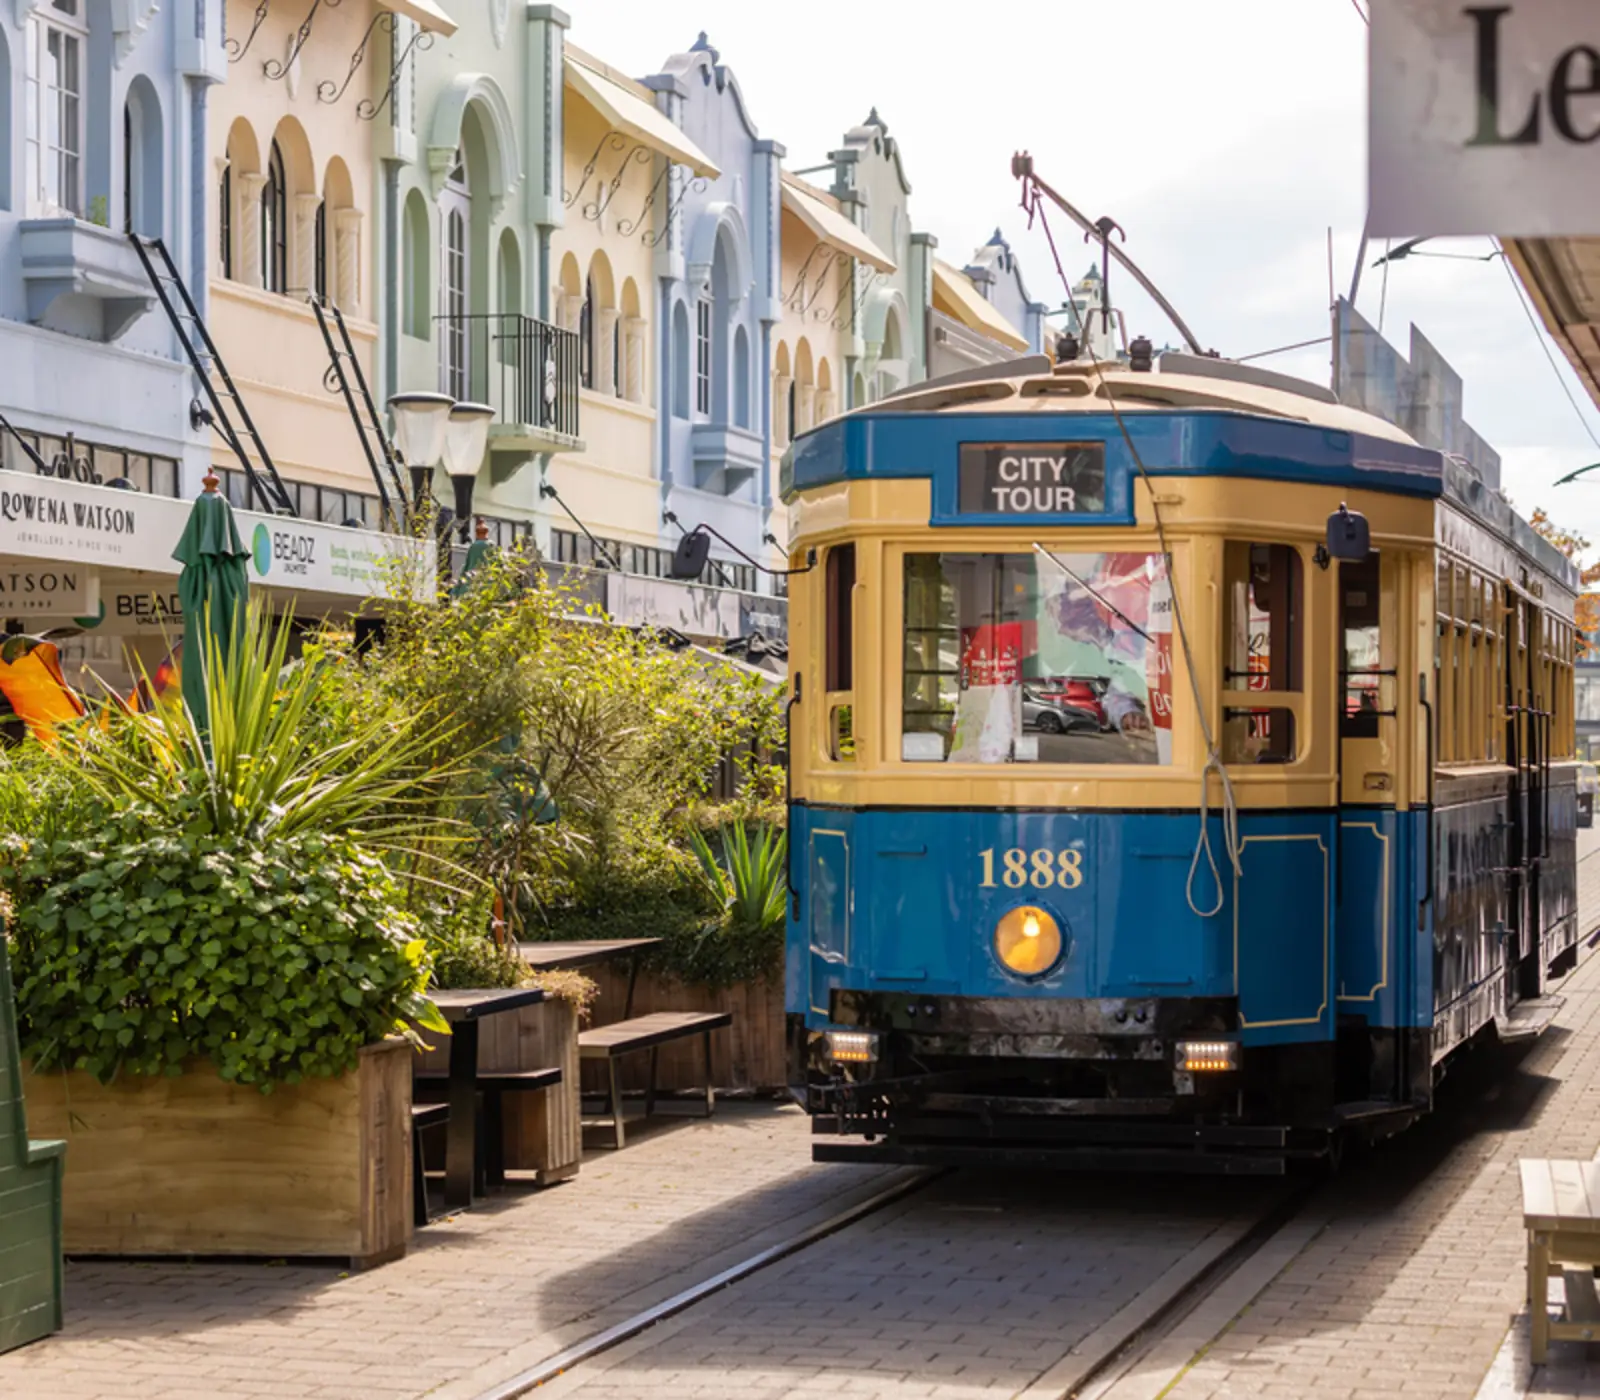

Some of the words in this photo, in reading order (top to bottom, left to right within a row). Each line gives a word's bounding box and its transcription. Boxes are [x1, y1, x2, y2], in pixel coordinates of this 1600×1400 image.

[1462, 4, 1600, 146] Le
[998, 456, 1067, 482] CITY
[1, 491, 68, 525] ROWENA
[73, 502, 135, 534] WATSON
[991, 486, 1076, 512] TOUR
[274, 532, 315, 564] BEADZ
[978, 848, 1083, 889] 1888
